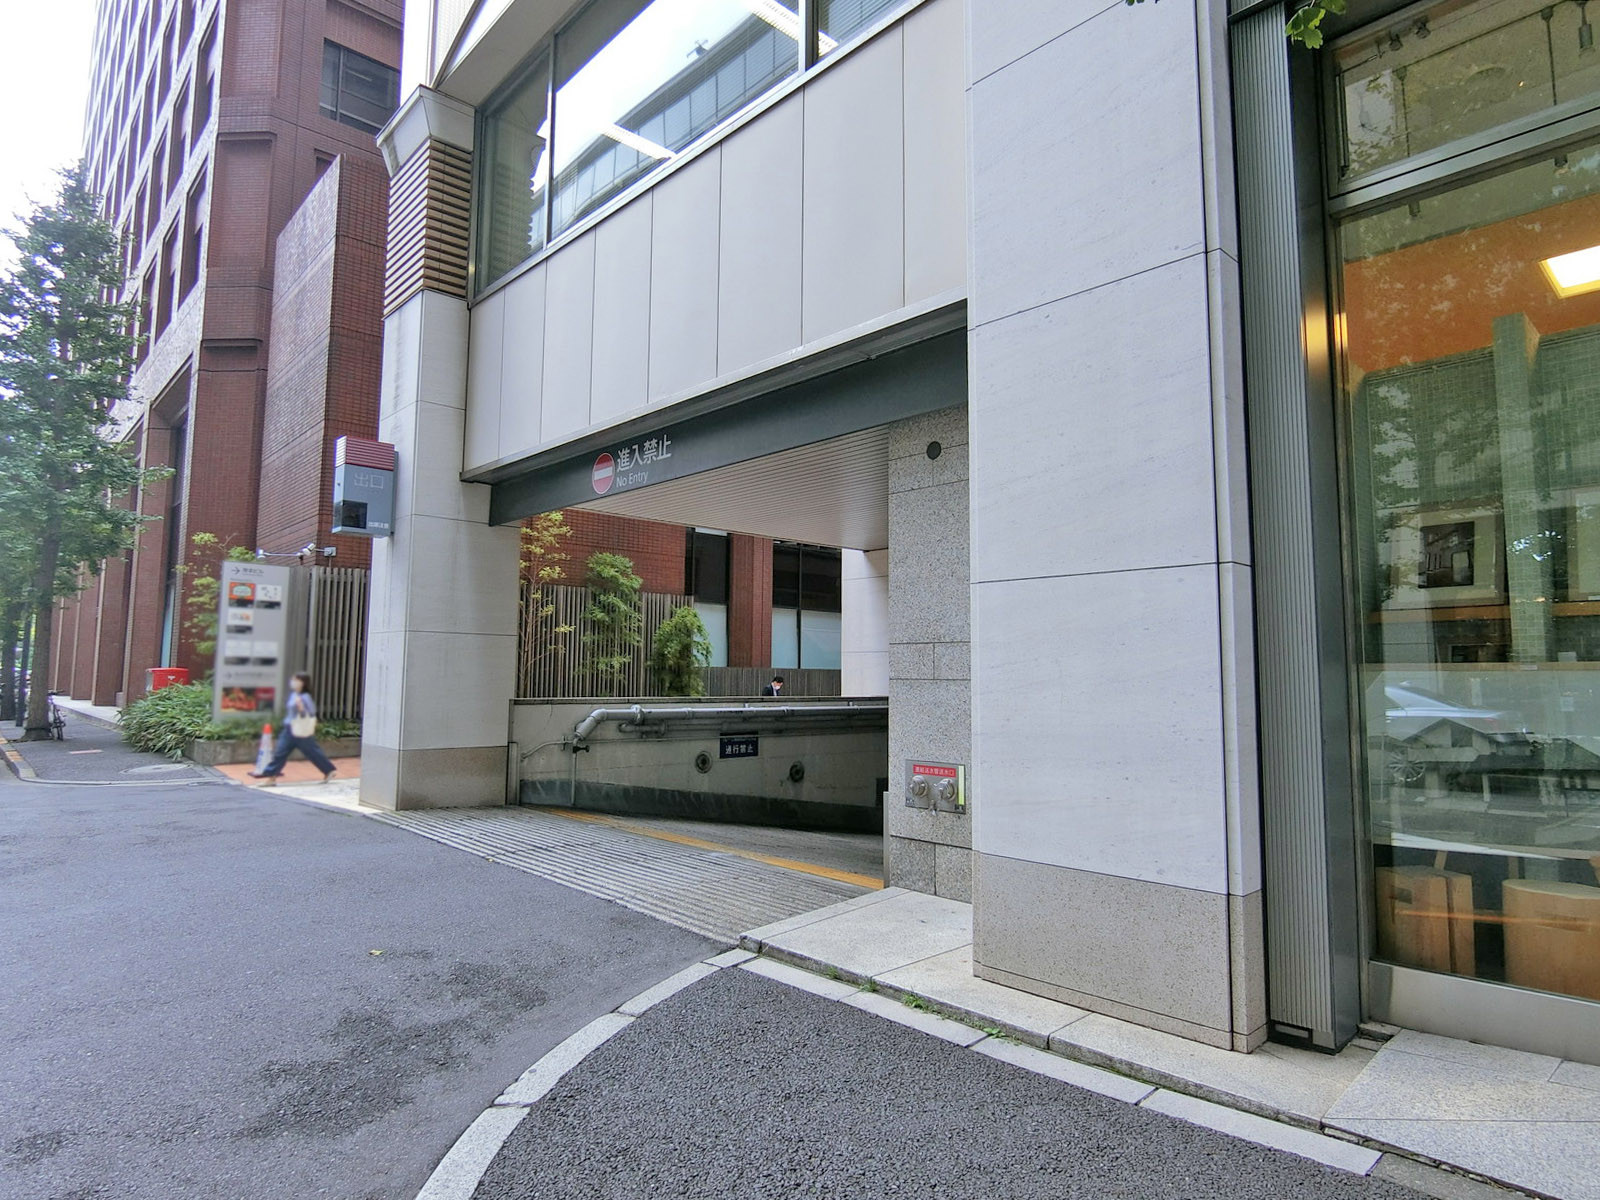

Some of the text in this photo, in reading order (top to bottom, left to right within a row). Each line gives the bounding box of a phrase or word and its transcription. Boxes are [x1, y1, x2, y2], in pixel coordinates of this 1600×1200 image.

[617, 434, 672, 472] 進入禁止
[354, 472, 384, 489] 出口
[616, 471, 649, 488] No Entry
